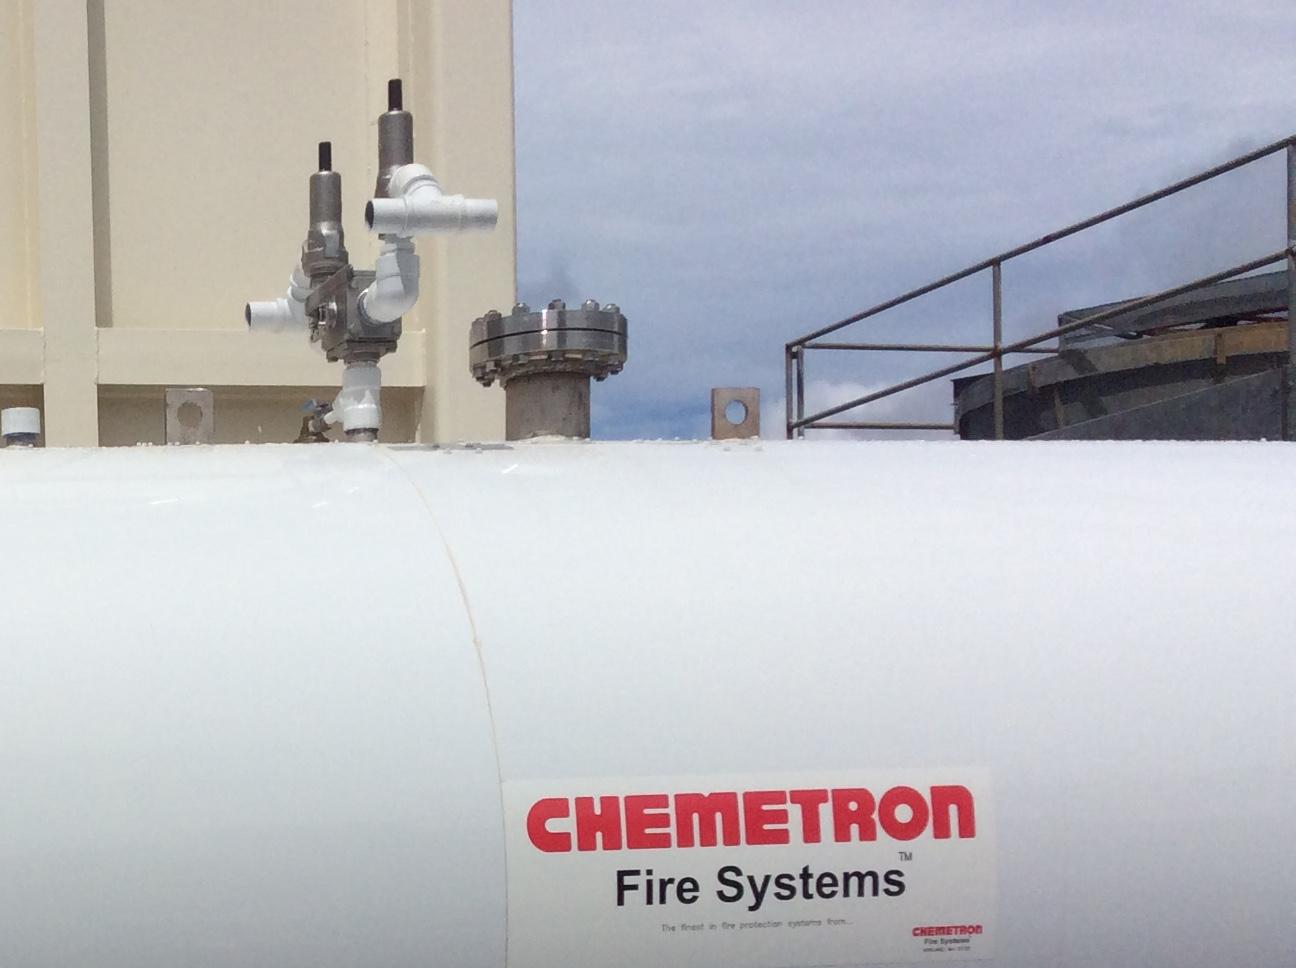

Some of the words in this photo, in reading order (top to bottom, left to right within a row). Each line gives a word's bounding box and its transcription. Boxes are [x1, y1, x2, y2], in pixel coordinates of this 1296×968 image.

[526, 785, 976, 853] CHEMETRON
[616, 868, 701, 907] Fire
[716, 864, 907, 912] Systems
[739, 920, 783, 931] protection
[788, 918, 822, 929] systems
